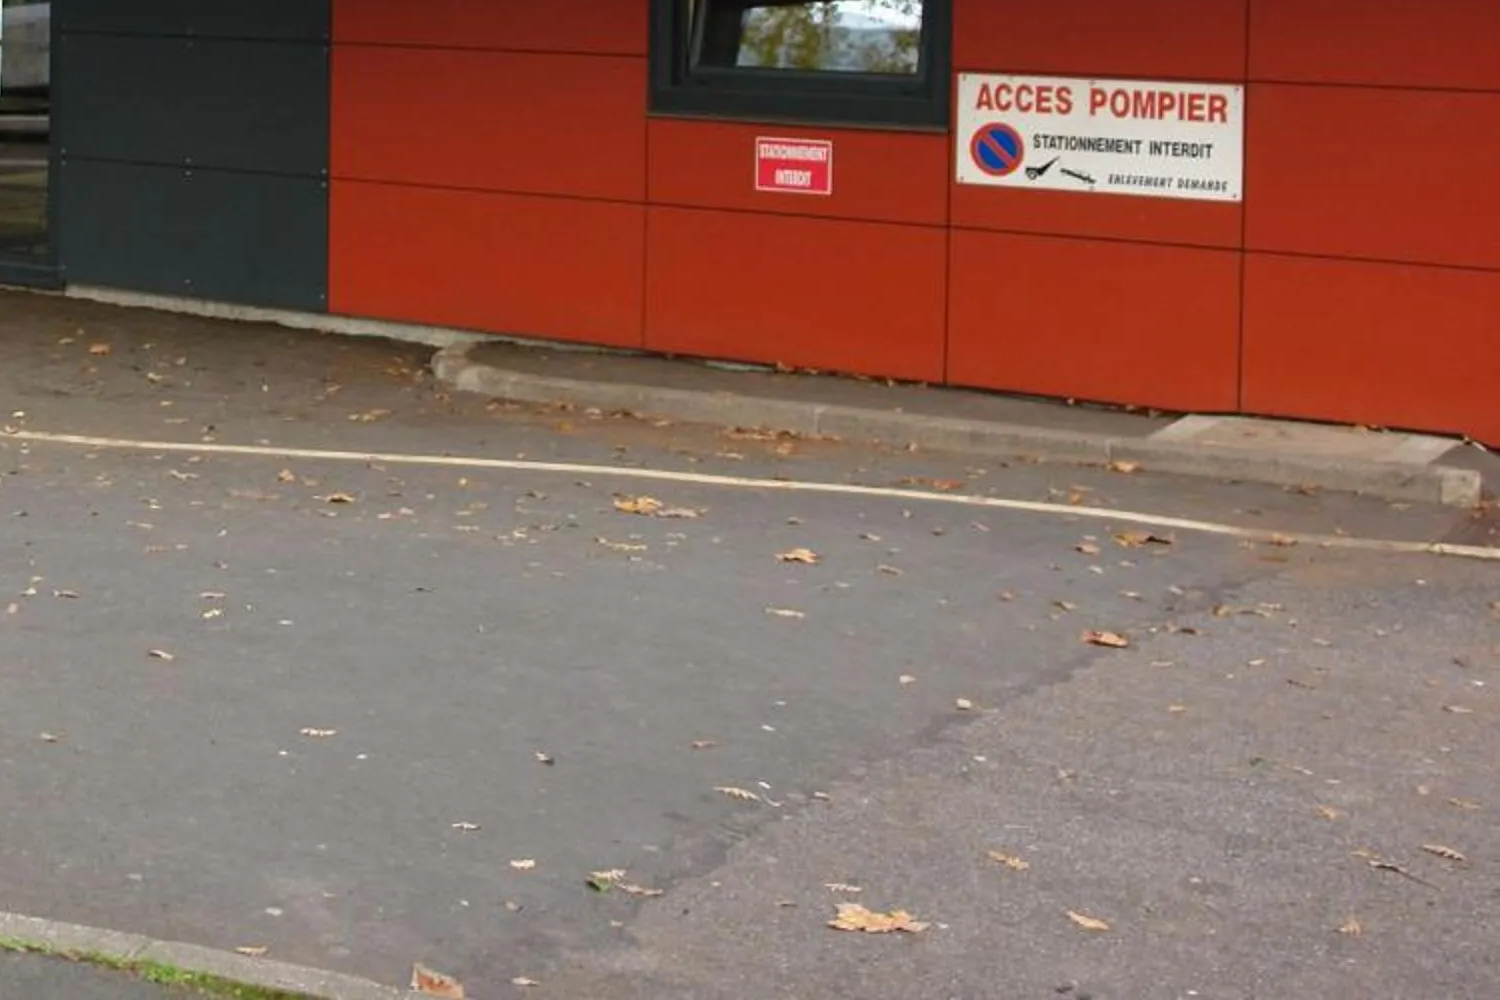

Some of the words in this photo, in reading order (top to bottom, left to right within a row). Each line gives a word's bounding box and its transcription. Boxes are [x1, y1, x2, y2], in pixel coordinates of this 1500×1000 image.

[975, 83, 1073, 115] ACCES
[1089, 87, 1228, 123] POMPIER
[760, 144, 827, 161] STATIONT
[1033, 133, 1142, 155] STATIONNEMENT
[1149, 141, 1213, 159] INTERDIT
